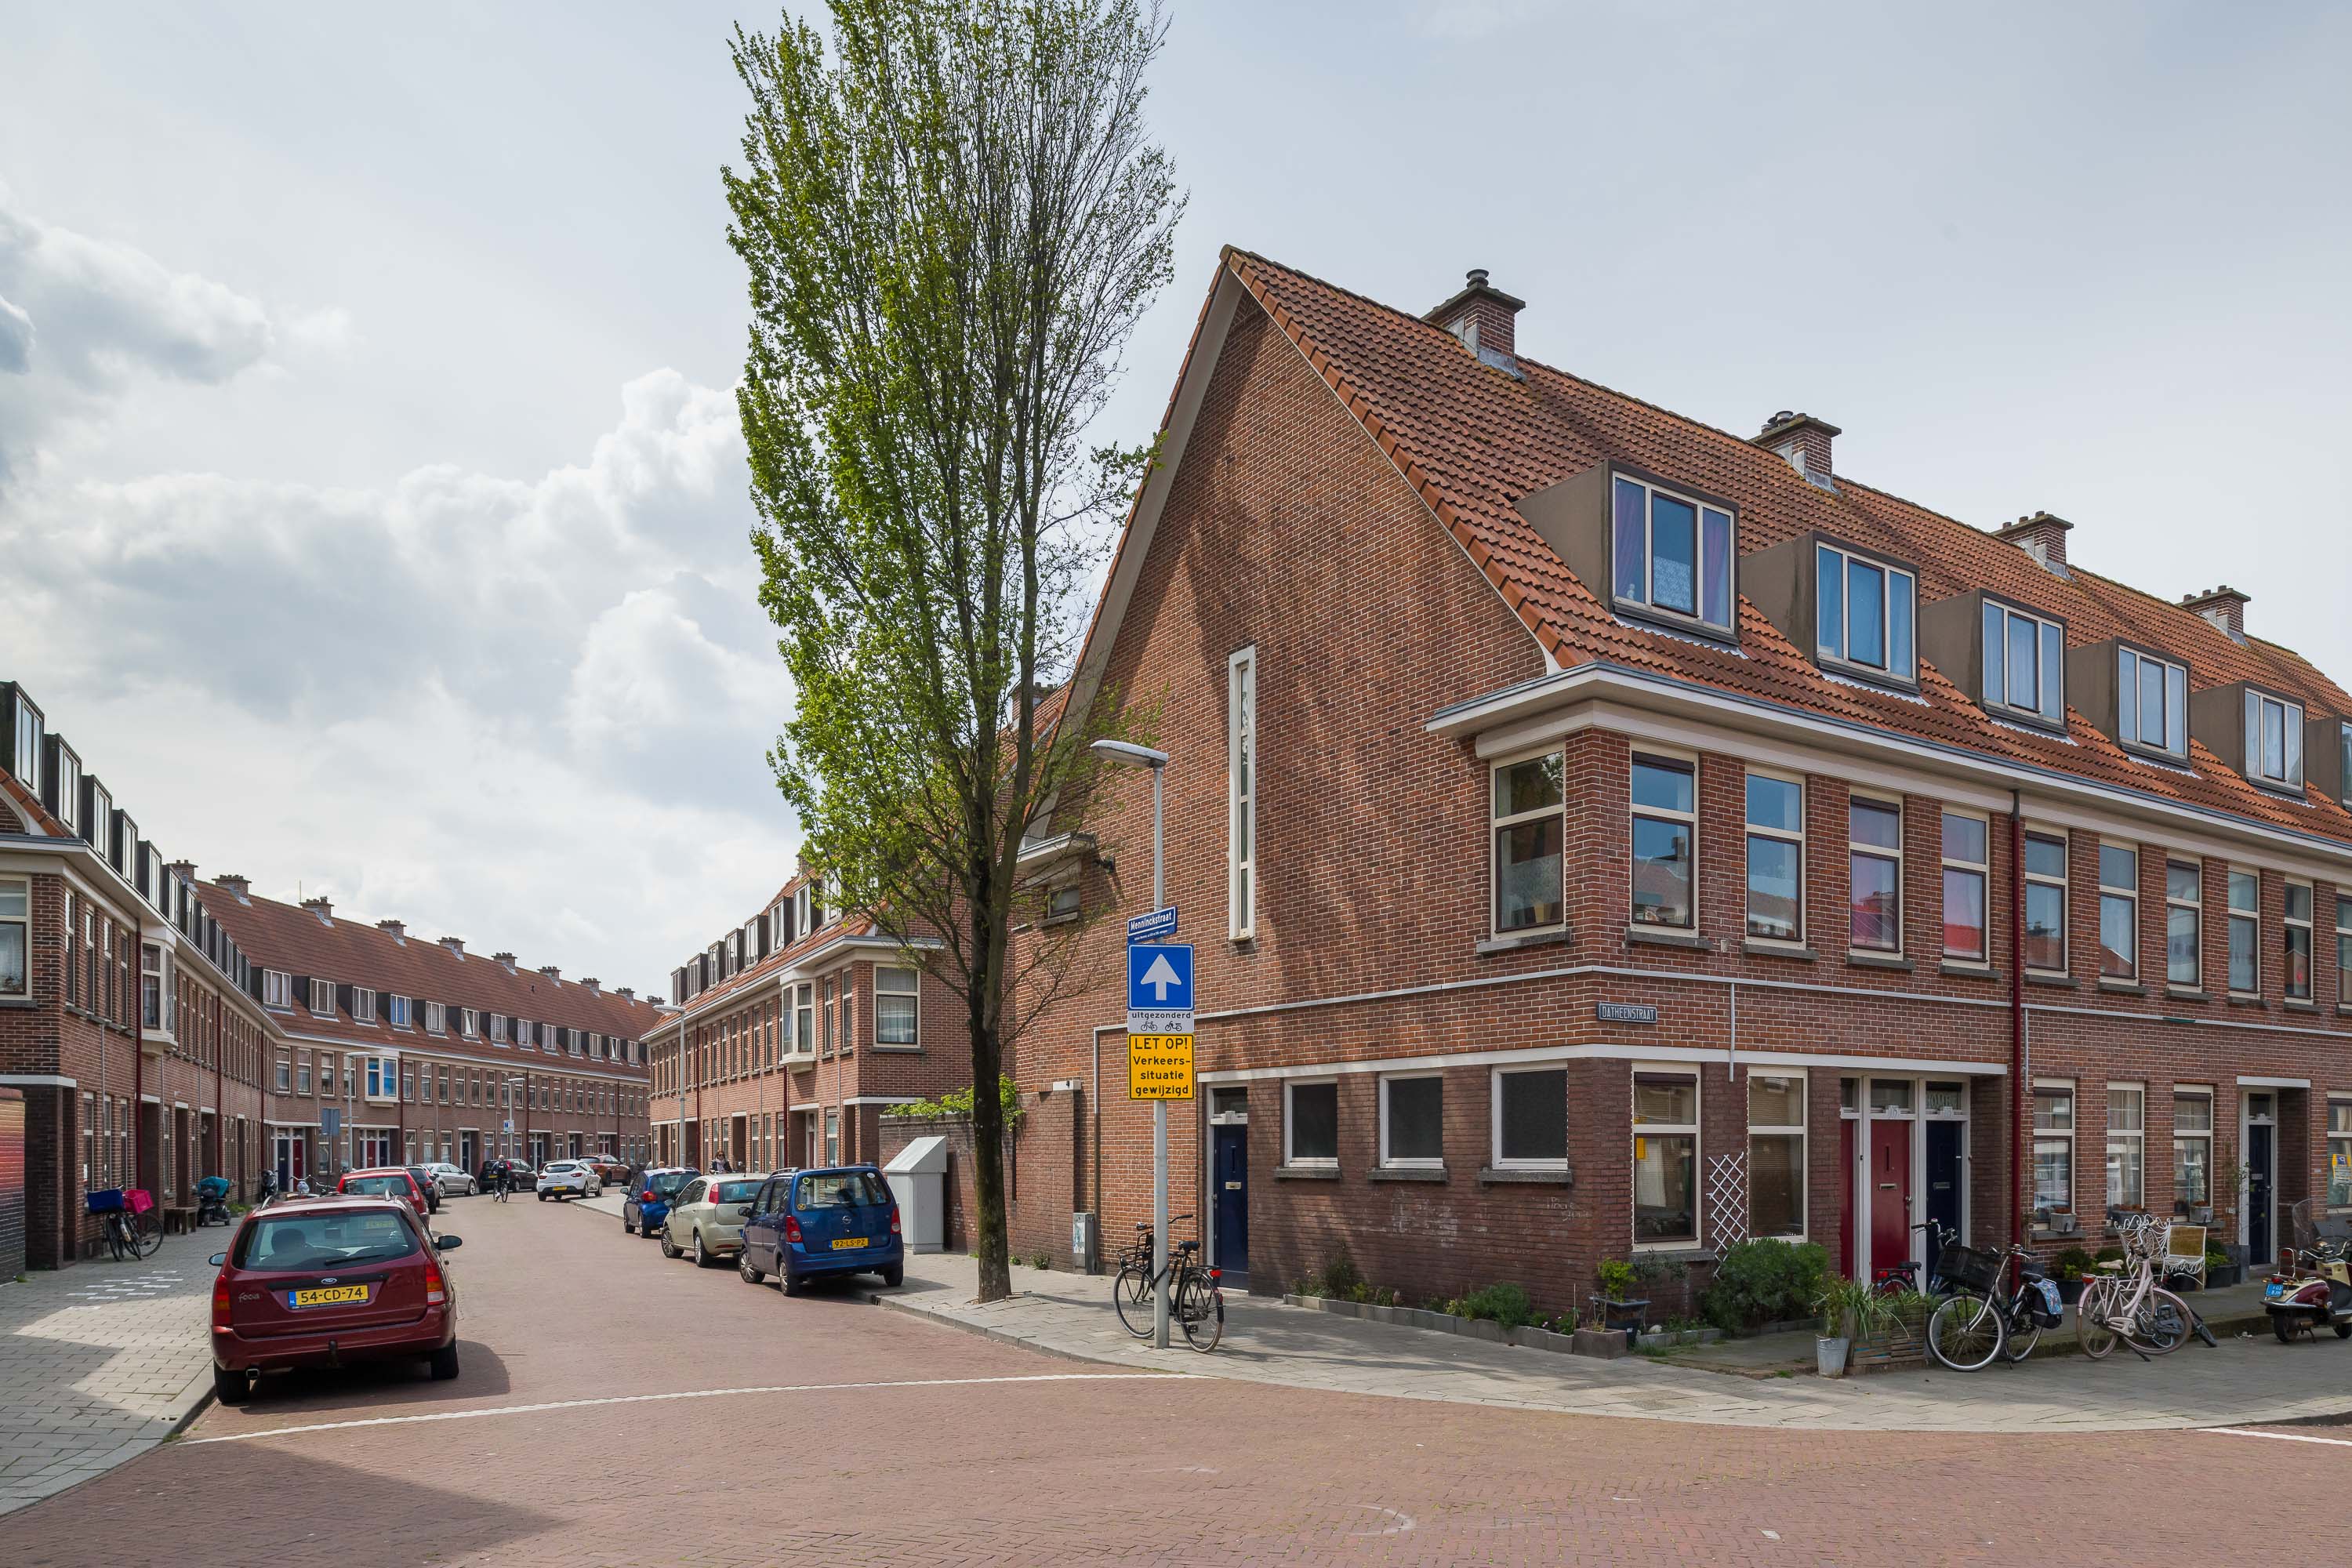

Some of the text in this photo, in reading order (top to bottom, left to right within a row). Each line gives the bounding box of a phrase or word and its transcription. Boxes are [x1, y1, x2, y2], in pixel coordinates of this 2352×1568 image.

[1131, 911, 1172, 931] Menninckstraat
[1131, 1011, 1191, 1020] uitgezonderd
[1602, 1006, 1654, 1021] DATHEENSTRAAT
[1134, 1037, 1188, 1050] LET OP!
[1133, 1055, 1191, 1065] Verkeers-
[1140, 1070, 1185, 1080] situatie
[1135, 1084, 1189, 1097] gewijzigd
[300, 1287, 363, 1303] 54-CD-74
